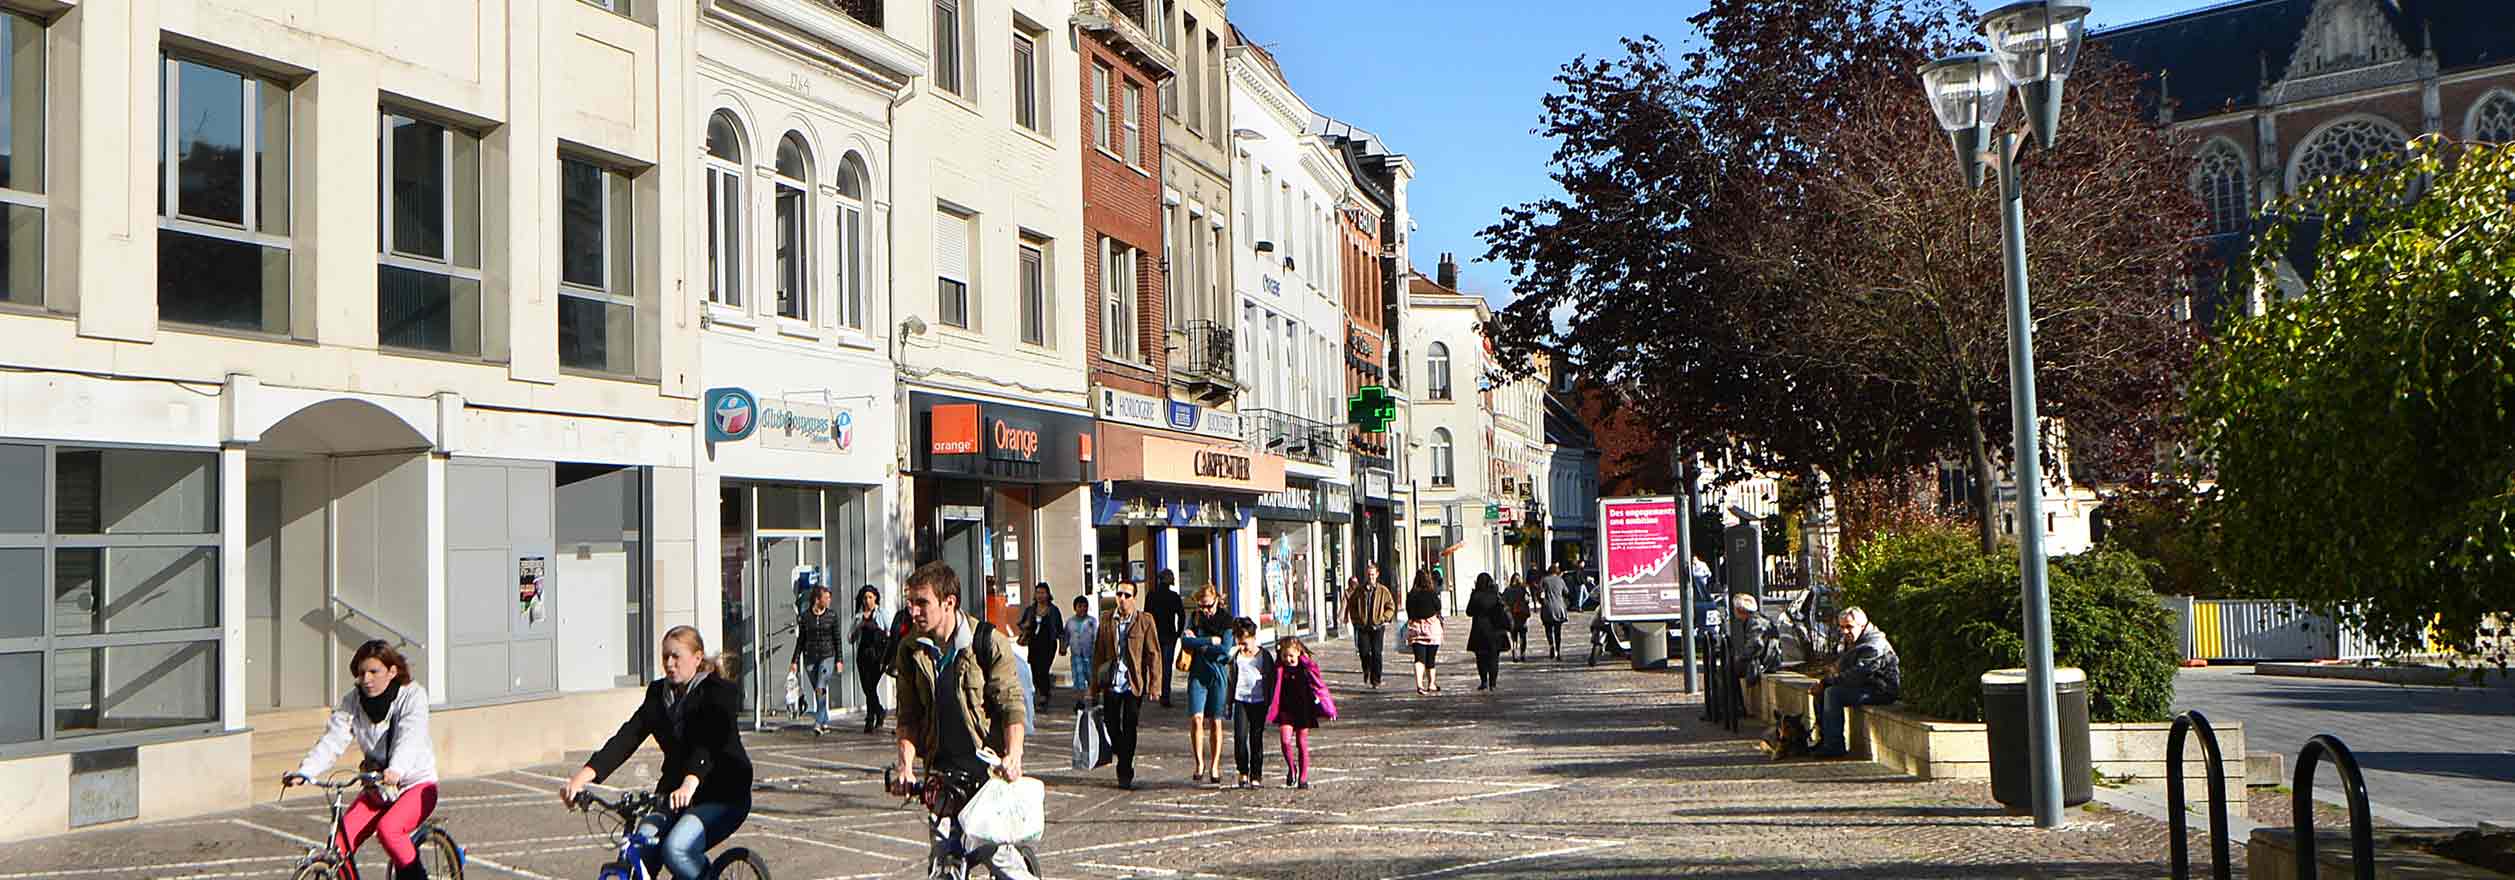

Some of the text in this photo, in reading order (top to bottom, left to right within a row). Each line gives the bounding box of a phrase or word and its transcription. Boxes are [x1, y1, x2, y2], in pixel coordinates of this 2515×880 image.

[934, 440, 972, 454] orange
[995, 419, 1038, 459] Orange
[1194, 450, 1251, 481] CARPENTIER
[1609, 509, 1624, 518] Des
